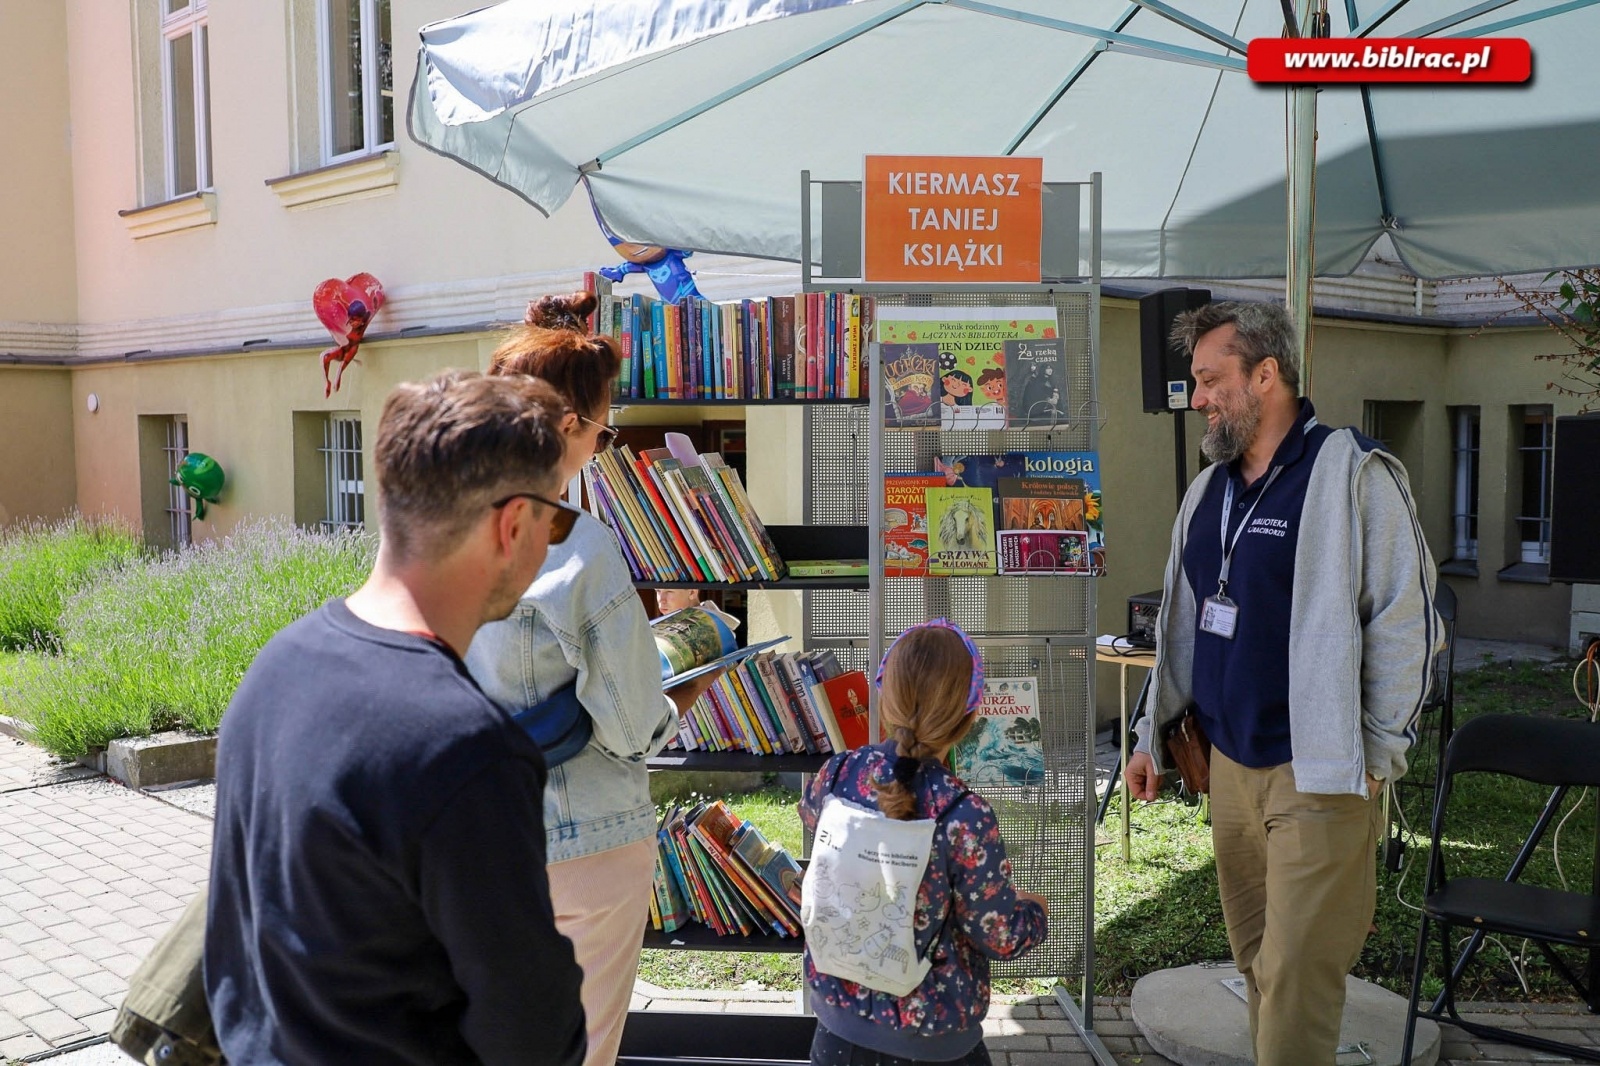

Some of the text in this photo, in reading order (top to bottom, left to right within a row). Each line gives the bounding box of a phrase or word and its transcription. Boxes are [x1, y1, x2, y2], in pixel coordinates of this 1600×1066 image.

[888, 172, 1020, 196] KIERMASZ
[908, 208, 999, 231] TANIEJ
[904, 238, 1003, 272] KSIĄŻKI
[939, 323, 1000, 332] Piknik rodzinny
[968, 331, 1019, 339] BIBLIOTEKA
[1024, 456, 1094, 476] kologia
[937, 550, 989, 561] GRZYWA
[980, 695, 1016, 706] URZE
